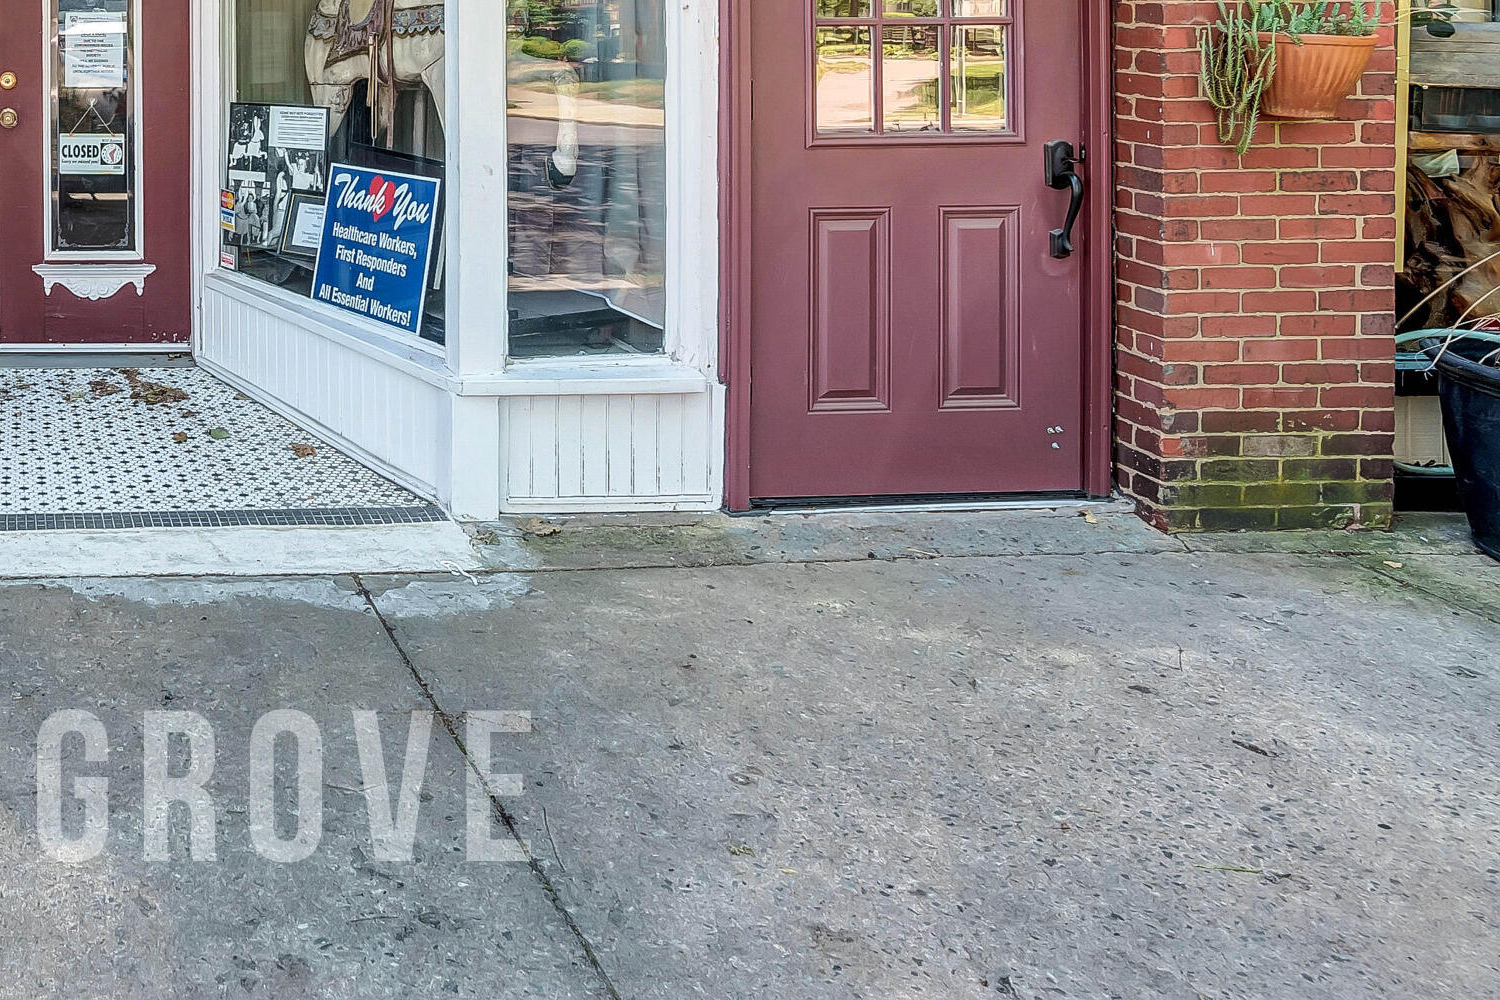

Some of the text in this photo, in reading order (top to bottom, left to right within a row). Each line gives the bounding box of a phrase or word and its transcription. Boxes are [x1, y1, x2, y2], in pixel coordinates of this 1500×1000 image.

[61, 144, 100, 159] CLOSED
[334, 172, 430, 231] Thank You
[332, 221, 379, 247] Healthcare
[378, 231, 418, 260] Workers,
[335, 244, 408, 278] First Responders
[355, 271, 375, 292] And
[318, 283, 412, 327] All Essential Workers!
